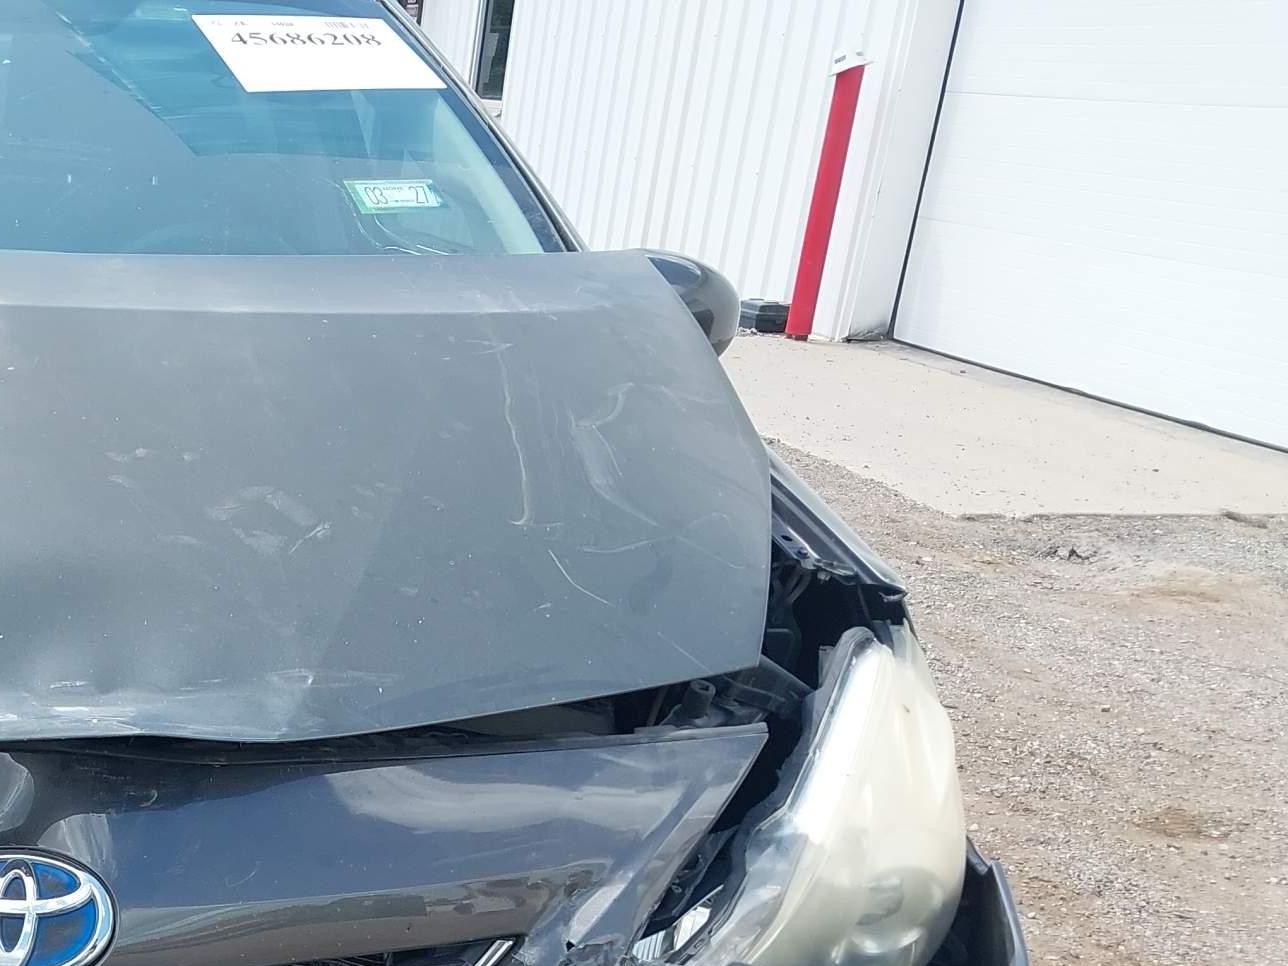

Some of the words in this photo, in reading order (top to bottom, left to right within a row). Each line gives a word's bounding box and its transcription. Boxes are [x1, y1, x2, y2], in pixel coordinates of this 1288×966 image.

[231, 32, 383, 46] 45686208
[364, 186, 389, 205] 03
[408, 186, 429, 204] 27
